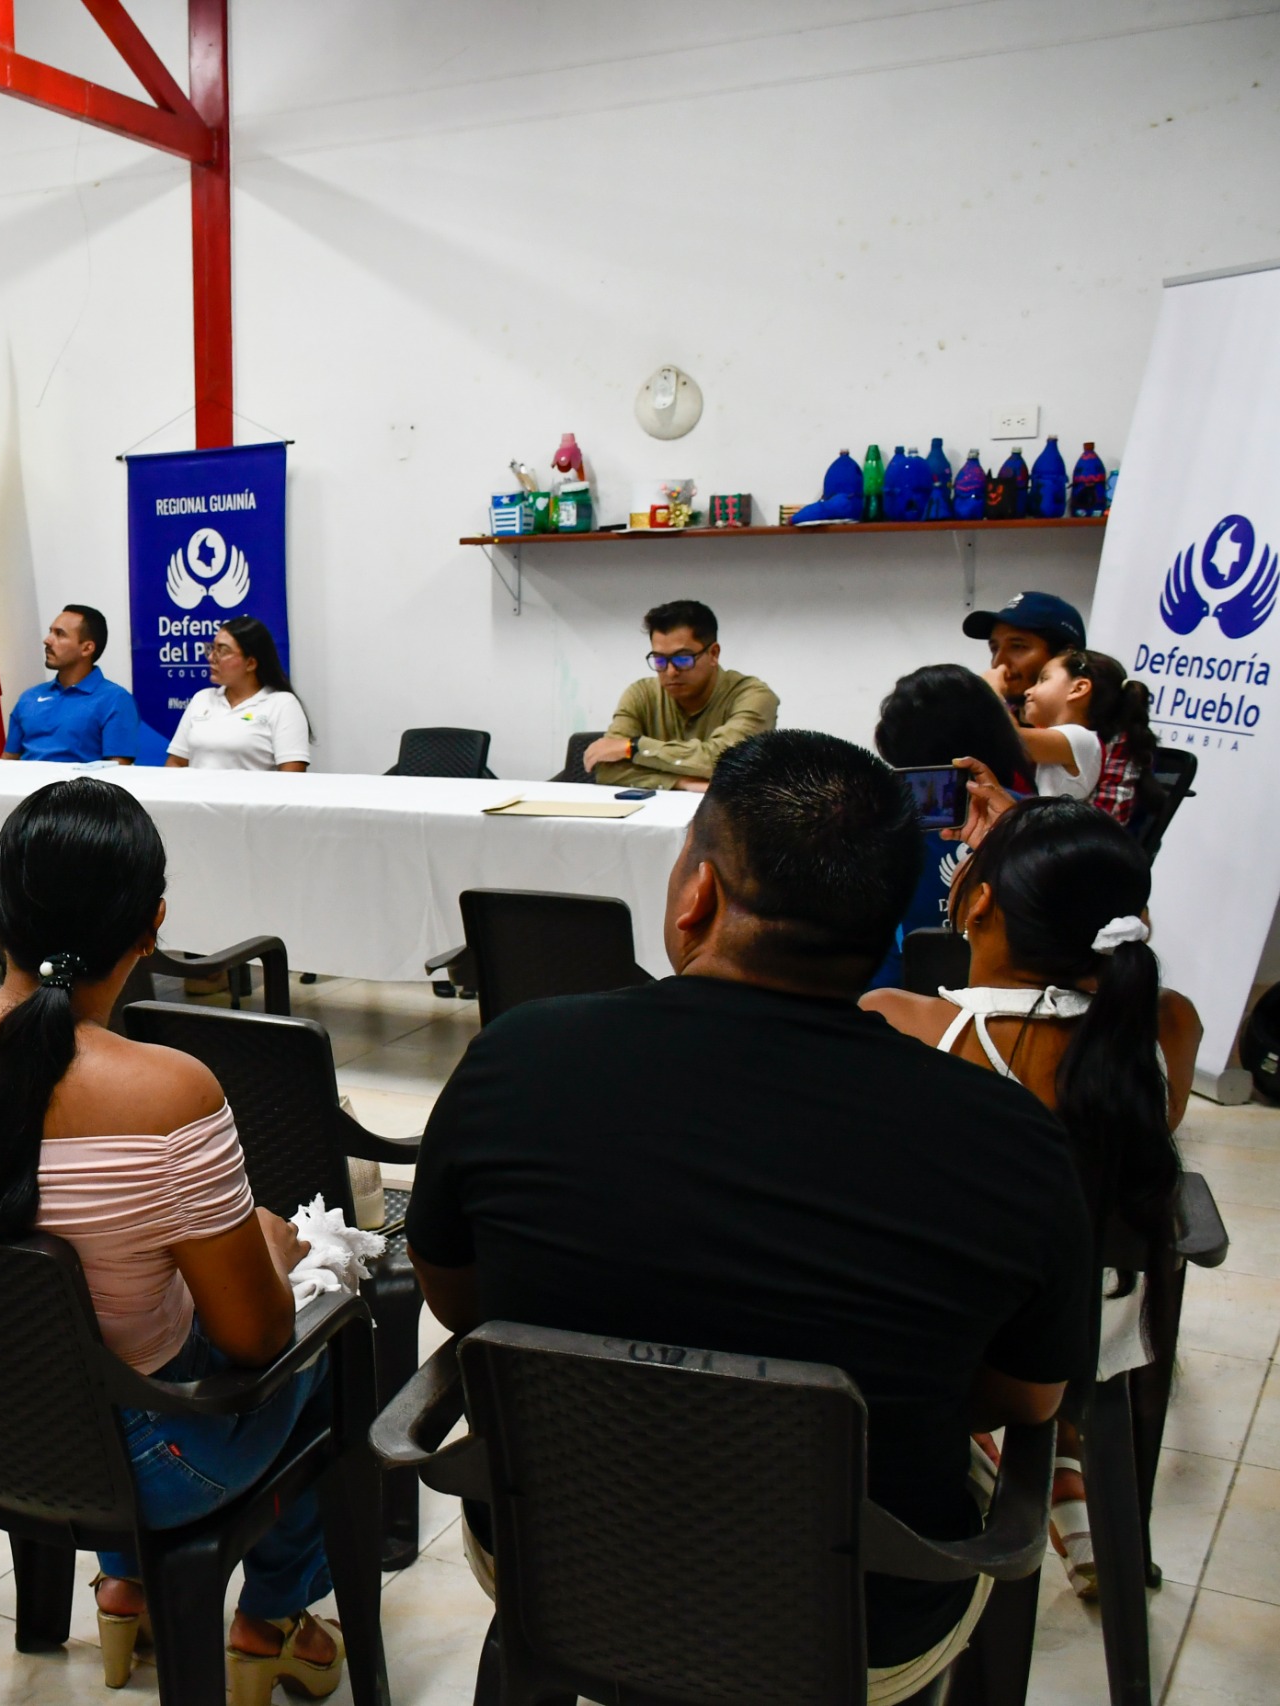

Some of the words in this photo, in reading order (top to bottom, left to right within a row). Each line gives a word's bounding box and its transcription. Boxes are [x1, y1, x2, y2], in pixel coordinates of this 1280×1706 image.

[156, 496, 208, 516] REGIONAL
[209, 487, 256, 512] GUAINÍA
[158, 615, 231, 636] Defens
[159, 641, 188, 662] del
[167, 669, 208, 678] COLO
[1134, 644, 1270, 685] Defensoría
[1170, 688, 1261, 728] Pueblo
[1156, 729, 1239, 752] LOMBIA
